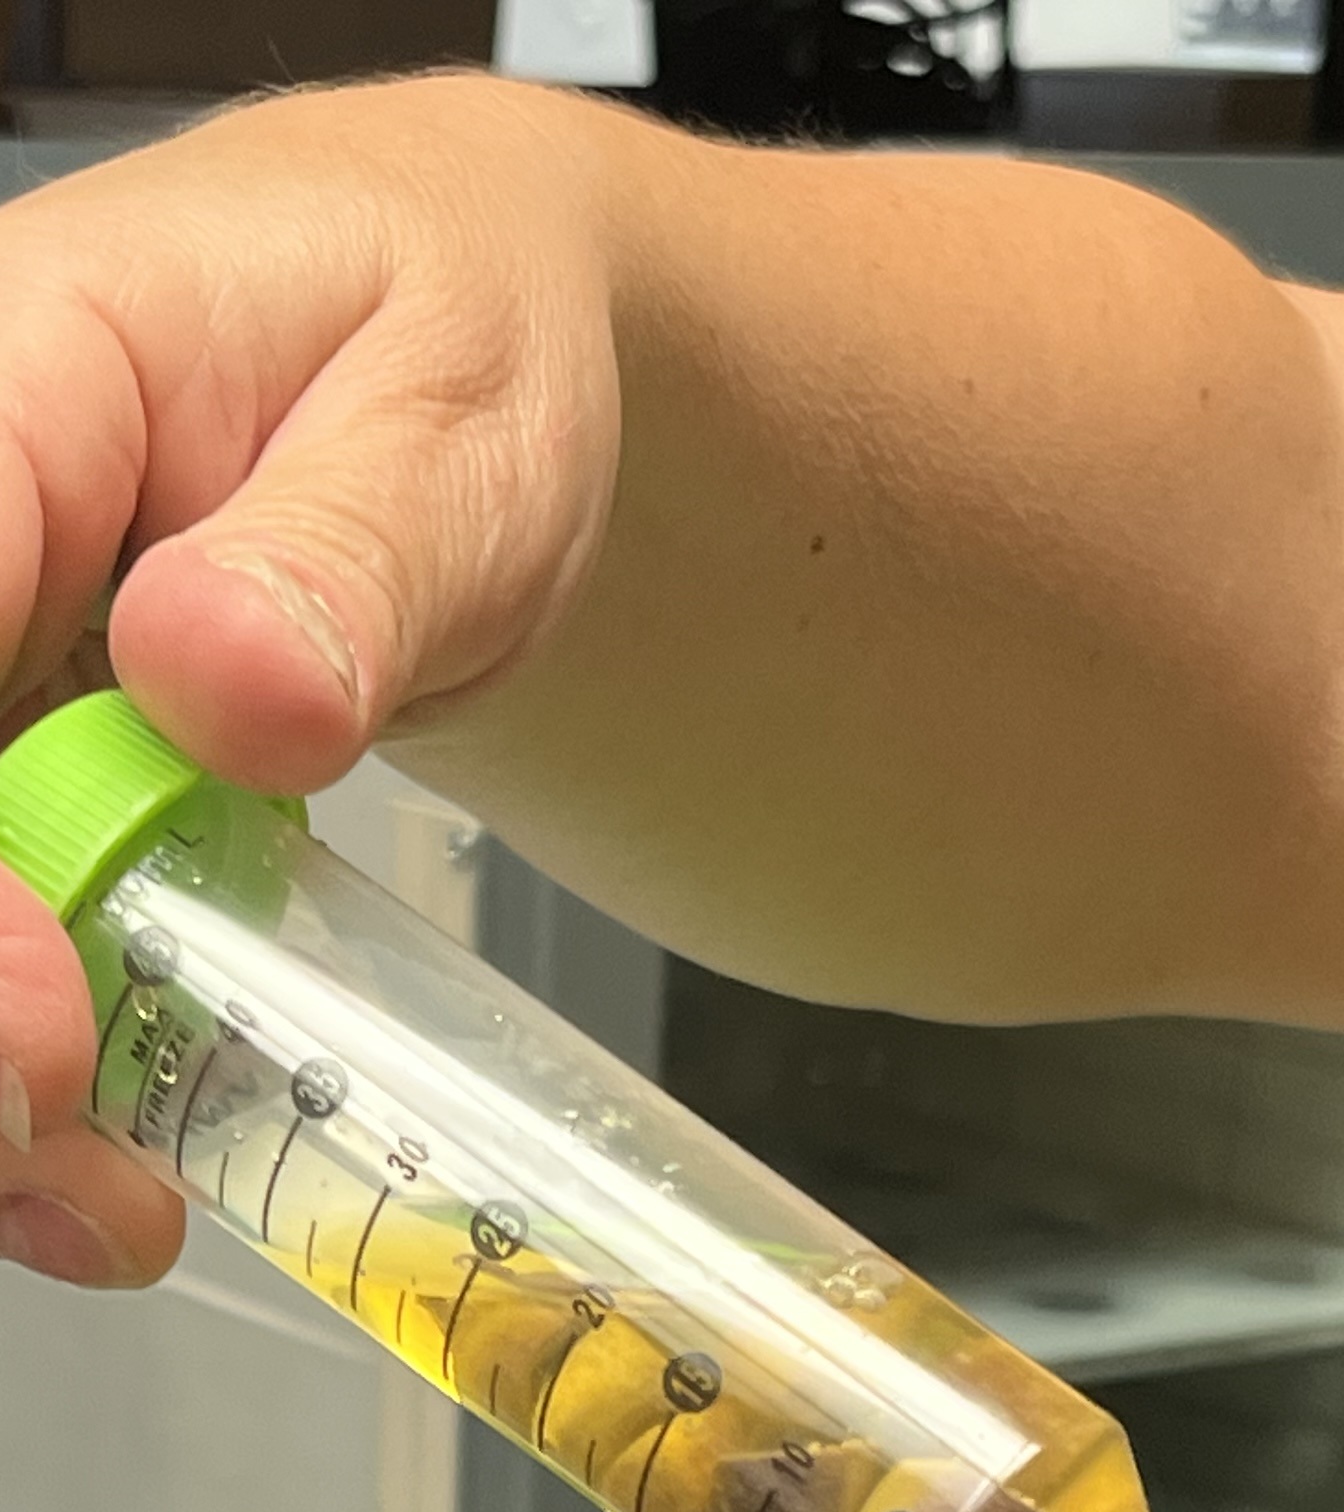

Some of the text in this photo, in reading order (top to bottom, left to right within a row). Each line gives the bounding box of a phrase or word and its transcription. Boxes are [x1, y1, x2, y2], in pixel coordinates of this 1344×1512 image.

[129, 1008, 172, 1066] MAX
[144, 1022, 197, 1130] FREEZE
[294, 1066, 342, 1114] 35
[386, 1135, 432, 1183] 30
[477, 1209, 521, 1256] 25
[571, 1282, 616, 1330] 20
[668, 1359, 719, 1408] 15
[769, 1440, 816, 1483] 10
